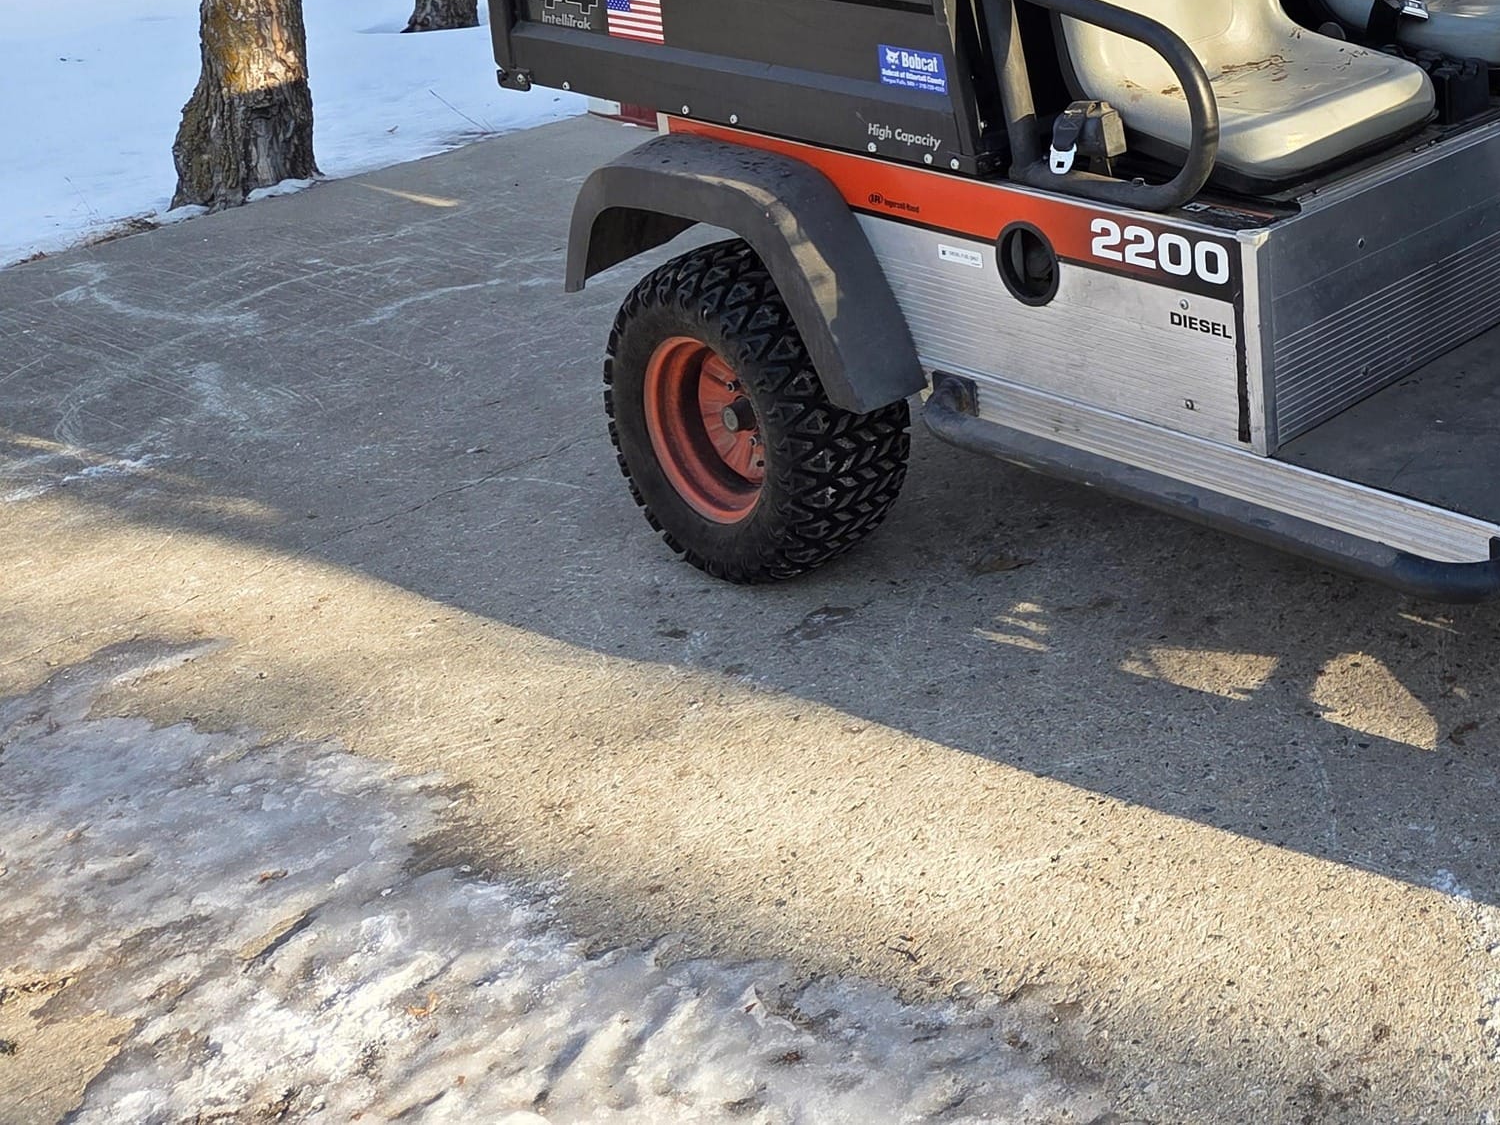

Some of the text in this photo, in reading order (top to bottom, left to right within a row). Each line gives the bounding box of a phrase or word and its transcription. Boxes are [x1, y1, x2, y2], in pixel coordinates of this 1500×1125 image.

[542, 11, 591, 31] IntelliTrak
[901, 51, 938, 73] Bobcat
[927, 76, 945, 86] County
[868, 123, 942, 151] High Capacity
[1090, 218, 1229, 285] 2200
[1170, 311, 1232, 339] DIESEL
